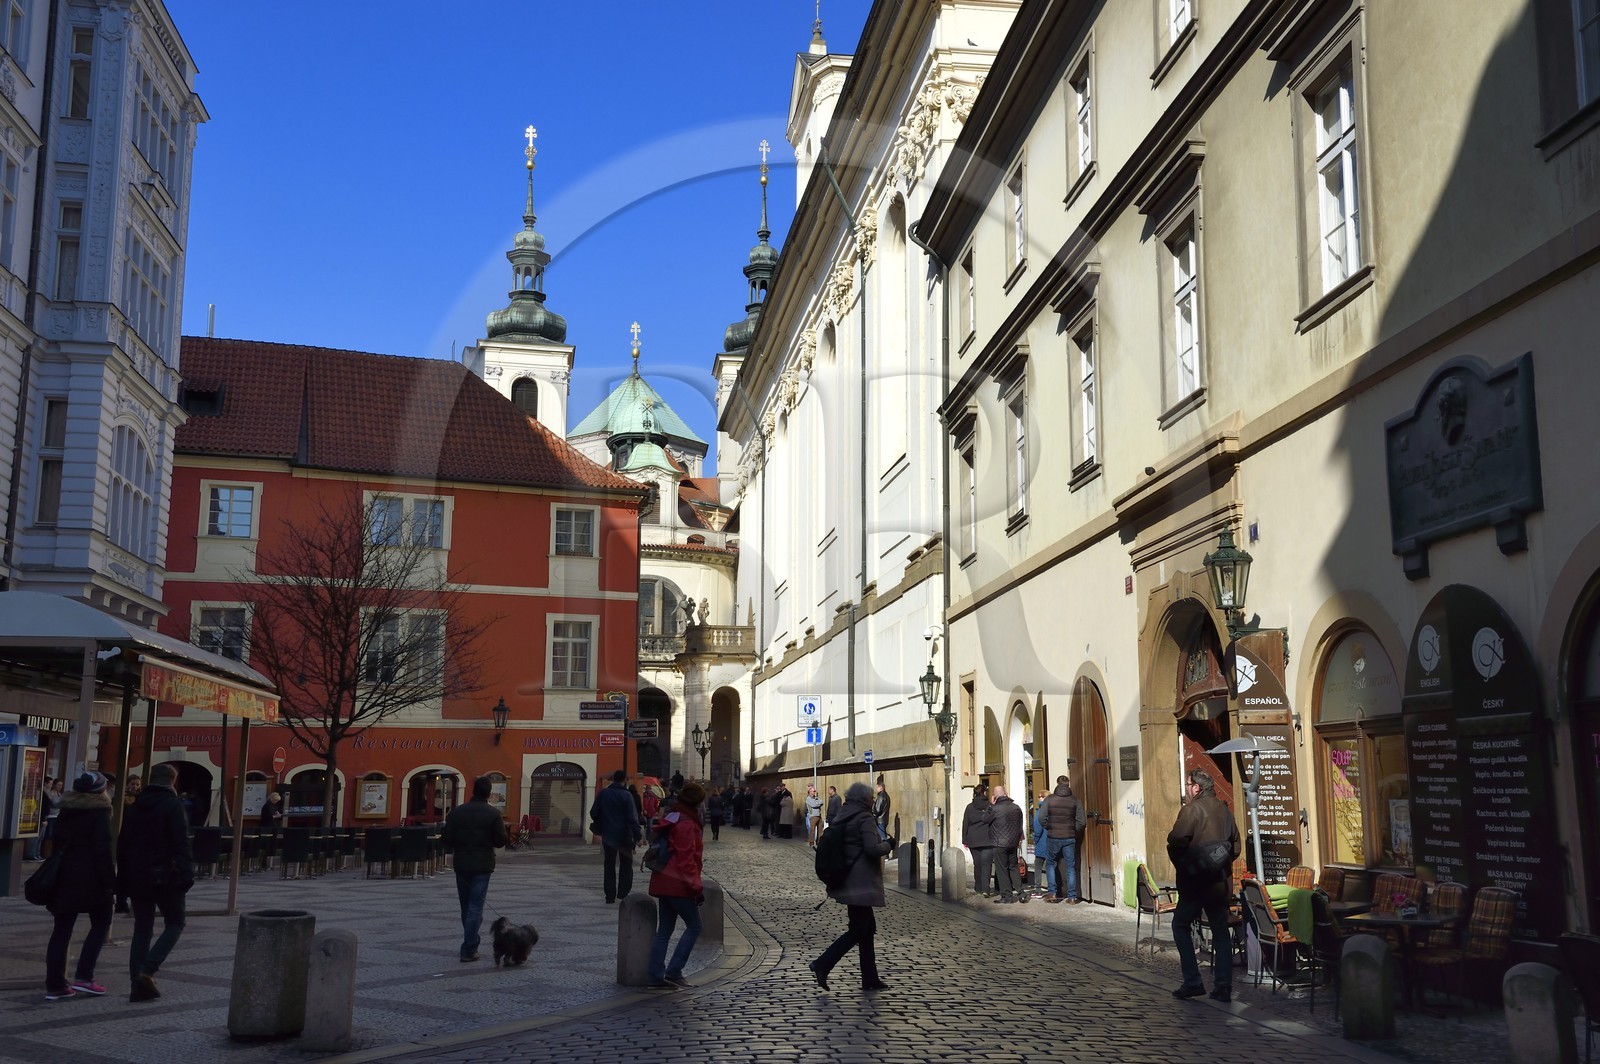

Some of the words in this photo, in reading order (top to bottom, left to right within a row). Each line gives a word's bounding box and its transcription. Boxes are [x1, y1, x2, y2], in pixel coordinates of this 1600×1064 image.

[1420, 678, 1440, 688] ENGLISH
[1244, 696, 1283, 704] ESPAÑOL
[354, 736, 472, 751] Restaurant
[523, 737, 598, 748] JEWELLERY
[1331, 750, 1352, 766] SOUP
[1424, 855, 1435, 863] MEAT
[1450, 858, 1464, 866] GRILL
[1504, 871, 1514, 880] NA
